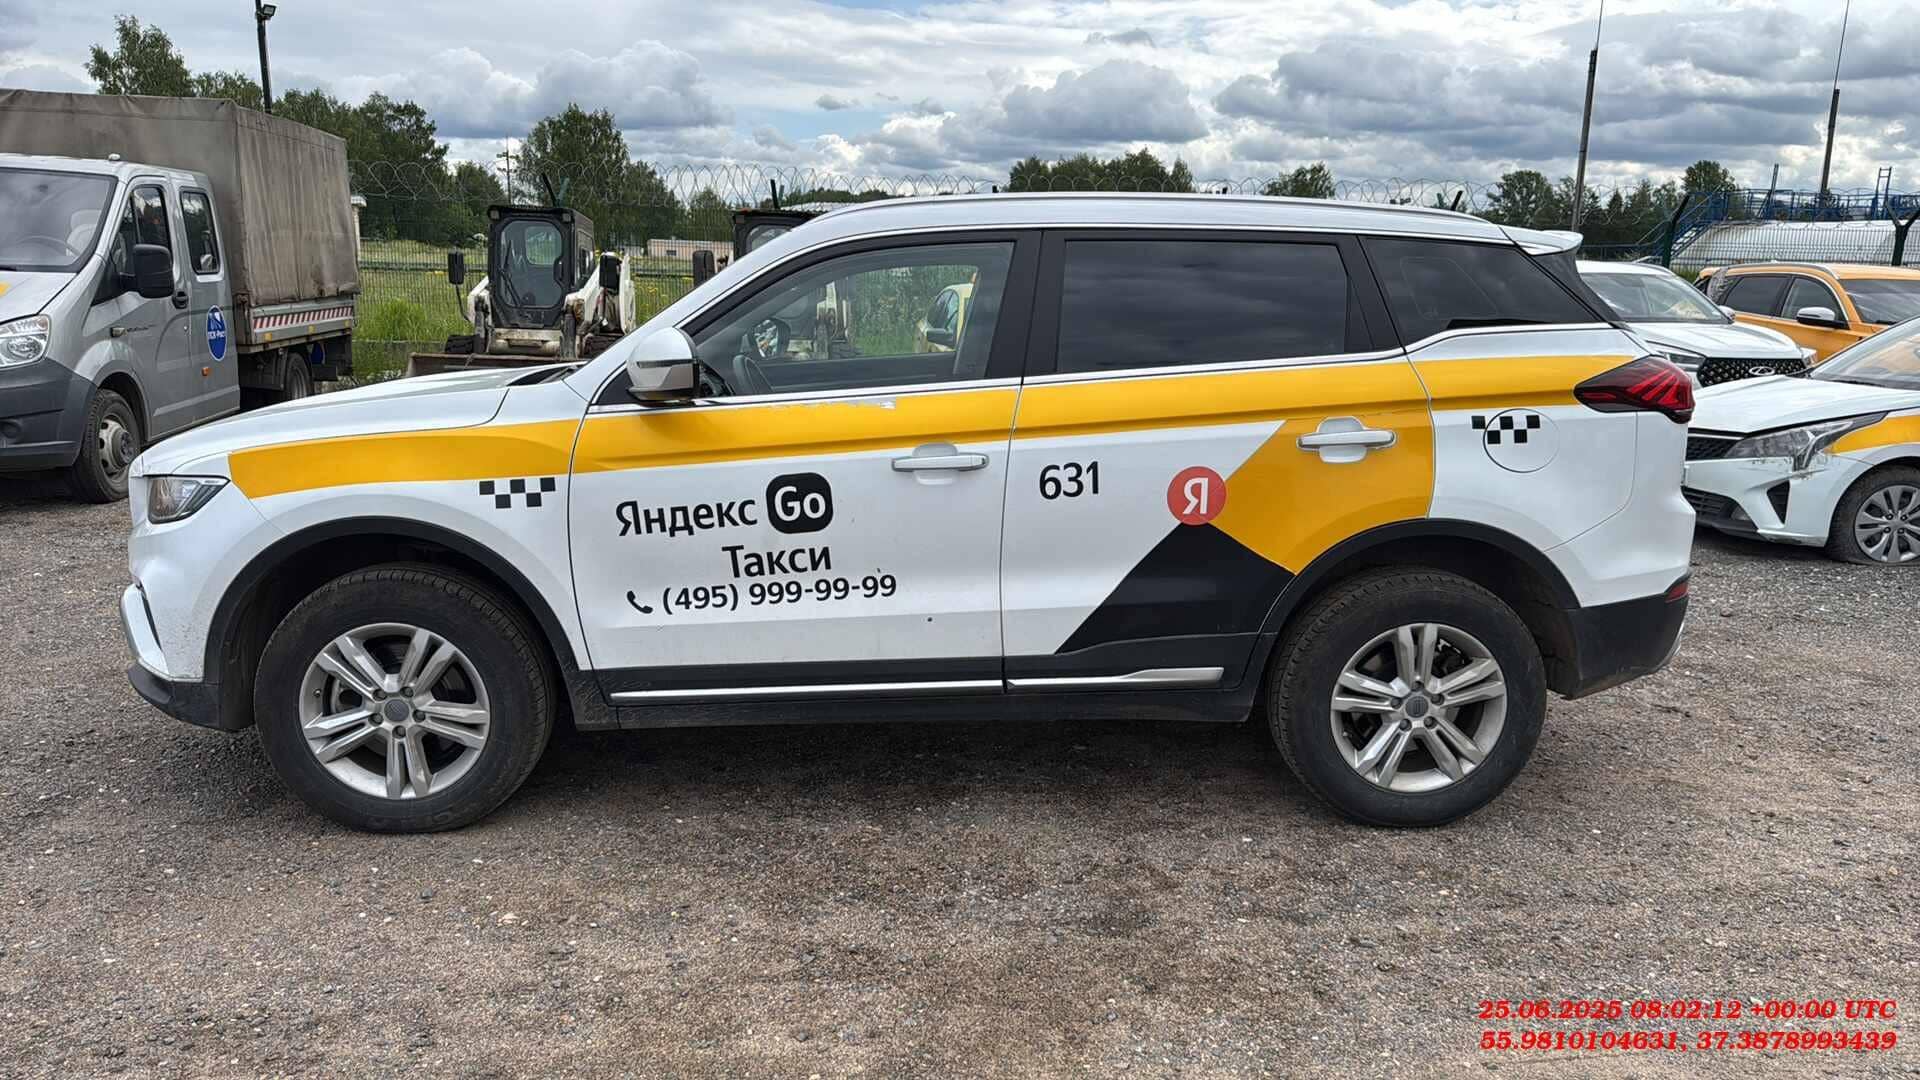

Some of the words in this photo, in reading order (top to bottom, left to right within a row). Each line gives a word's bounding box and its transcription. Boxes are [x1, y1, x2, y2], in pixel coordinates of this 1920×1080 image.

[1039, 460, 1100, 500] 631
[1182, 476, 1210, 515] Я
[615, 499, 758, 538] Яндекс
[773, 486, 827, 521] Go
[721, 544, 832, 579] Такси
[662, 583, 739, 615] (495)
[748, 574, 897, 606] 999-99-99
